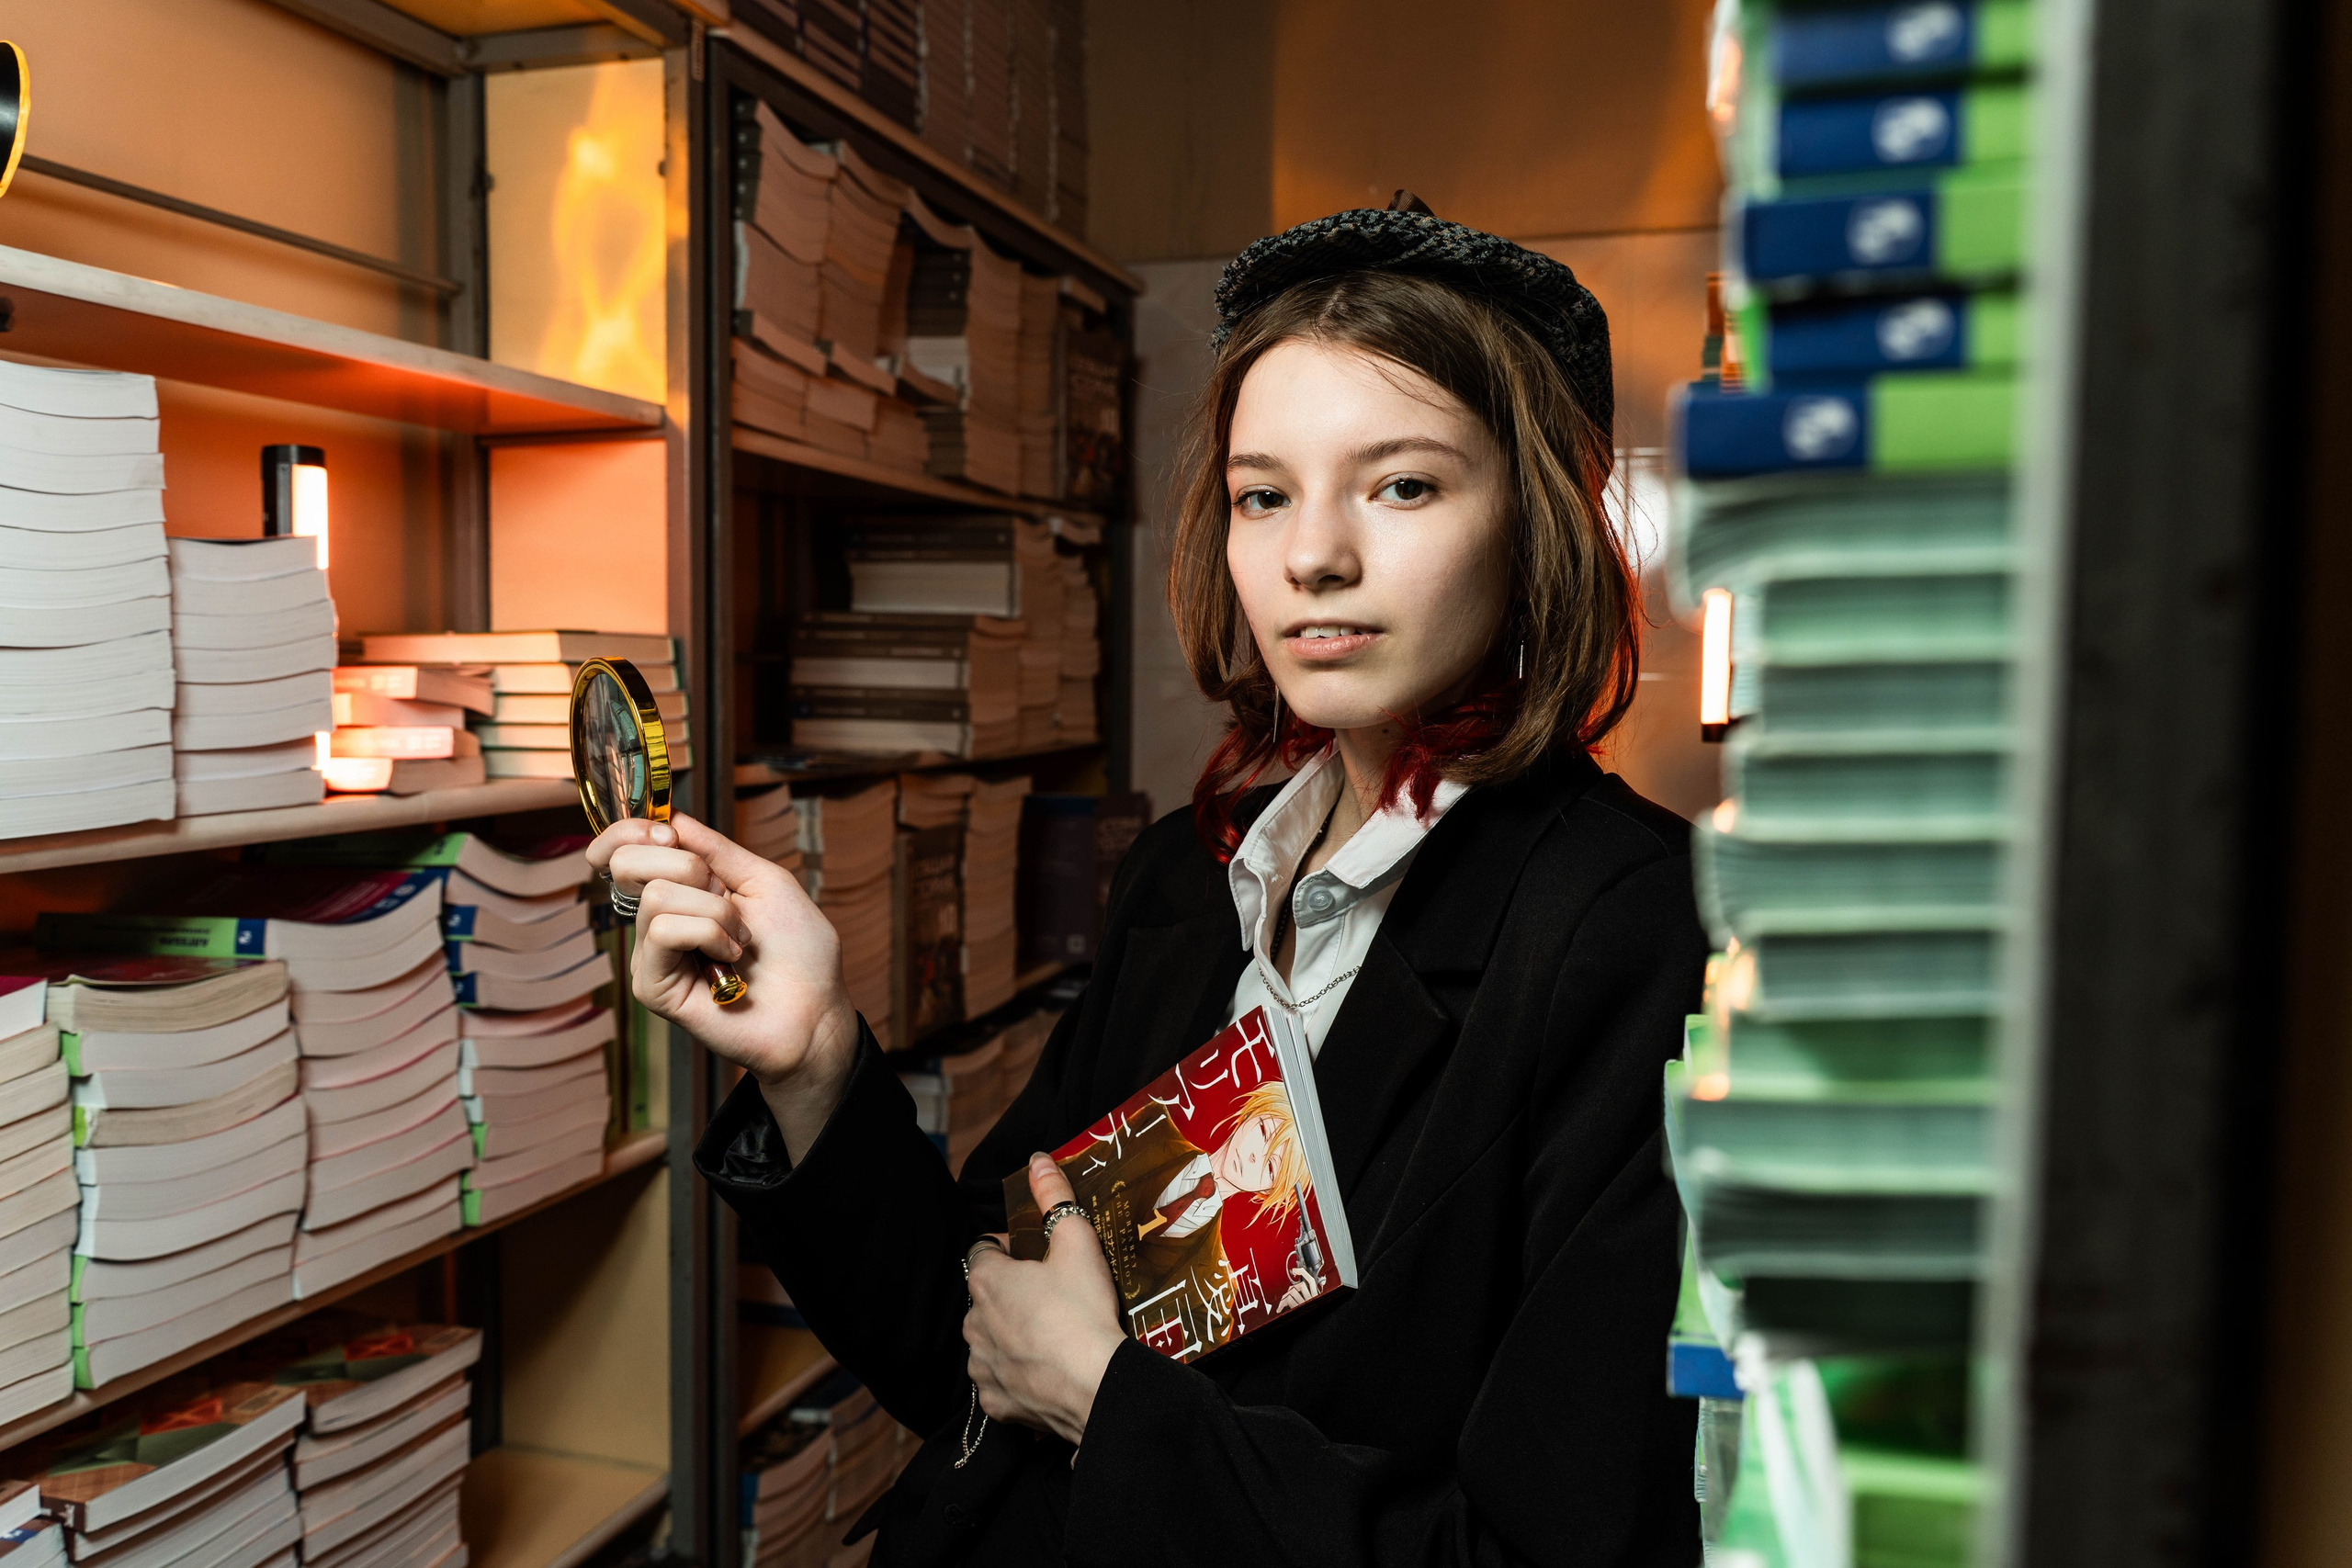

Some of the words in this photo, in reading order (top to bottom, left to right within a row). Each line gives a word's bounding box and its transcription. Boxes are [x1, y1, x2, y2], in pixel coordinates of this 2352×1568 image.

[1081, 1015, 1275, 1178] モリアーティ
[1120, 1229, 1132, 1286] PATRIOT
[1124, 1201, 1137, 1268] MORIARTY
[1137, 1208, 1170, 1241] 1
[1127, 1247, 1273, 1360] 憂国
